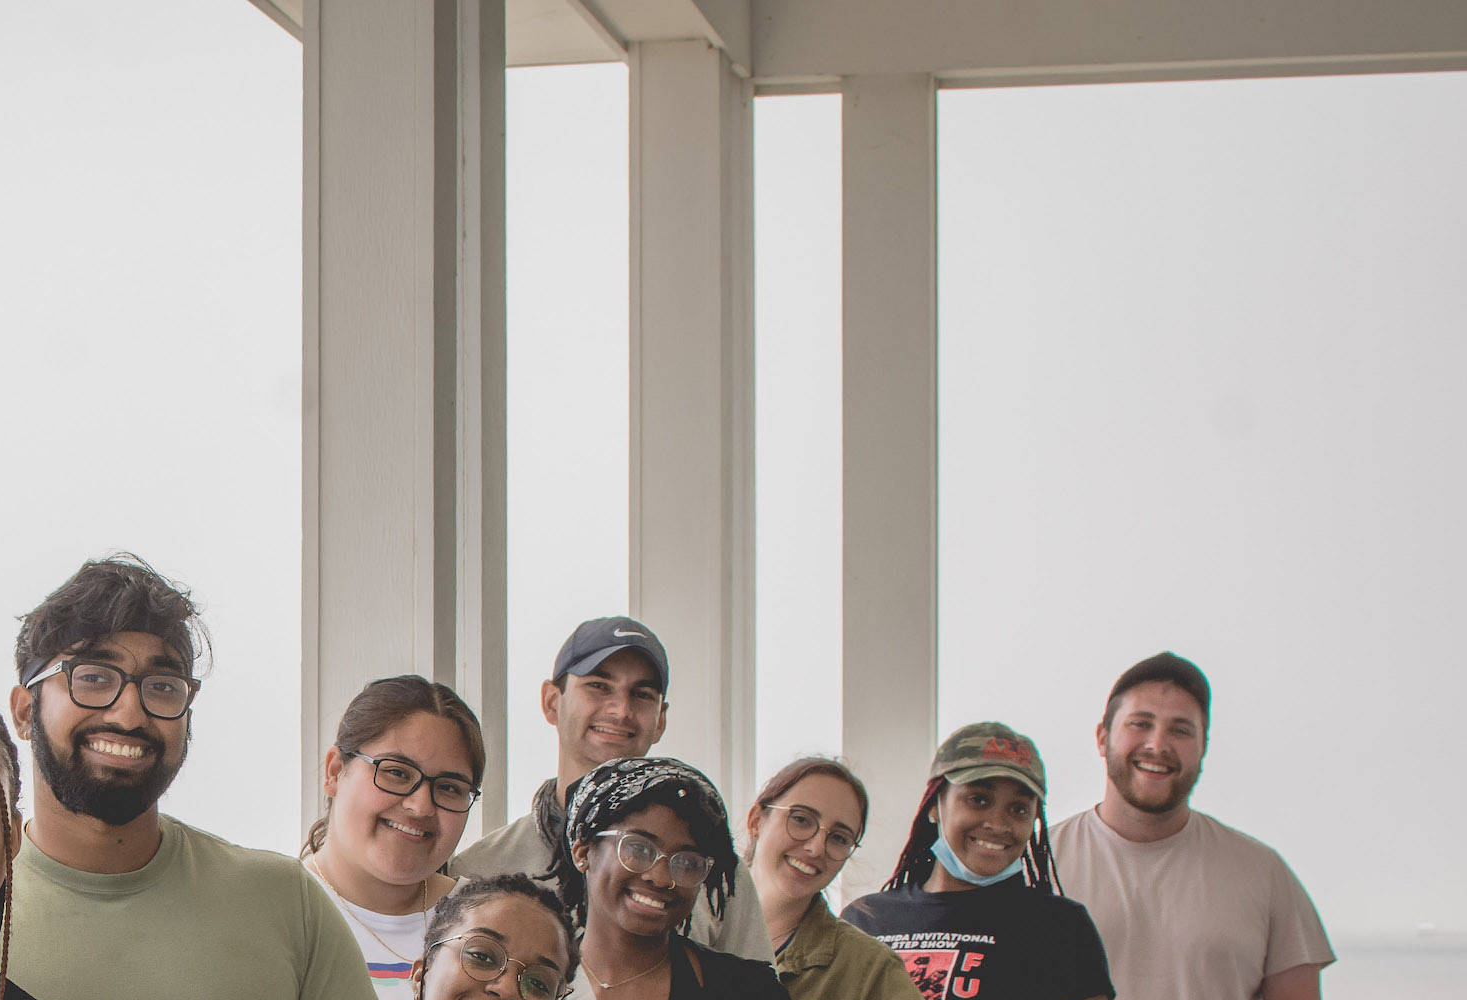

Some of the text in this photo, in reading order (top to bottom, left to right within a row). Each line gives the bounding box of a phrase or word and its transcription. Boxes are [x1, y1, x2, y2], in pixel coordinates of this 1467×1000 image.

[911, 932, 996, 945] INVITATIONAL
[890, 941, 959, 950] STEP SHOW
